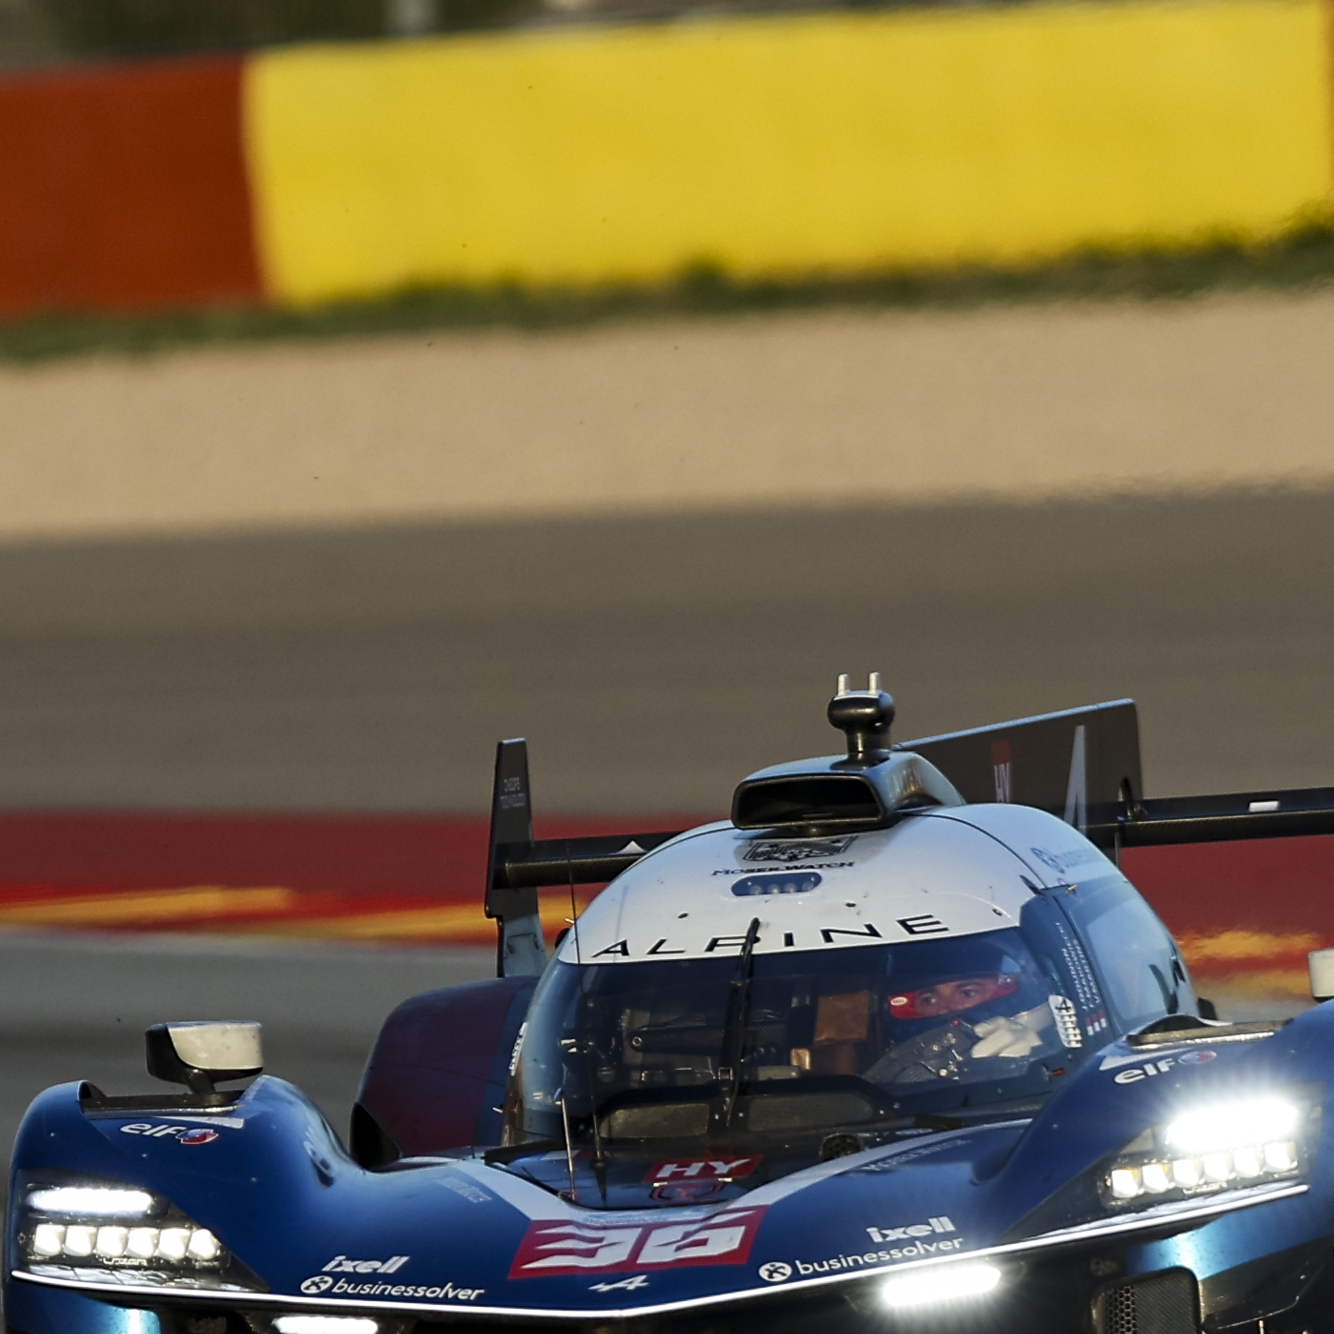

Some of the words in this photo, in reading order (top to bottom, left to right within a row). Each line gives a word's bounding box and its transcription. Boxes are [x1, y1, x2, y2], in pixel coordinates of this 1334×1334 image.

[592, 913, 949, 958] ALPINE
[1114, 1058, 1176, 1084] elf
[120, 1122, 188, 1138] elf
[654, 1158, 752, 1179] HY
[522, 1210, 756, 1268] 36
[866, 1215, 956, 1243] ixell
[321, 1255, 410, 1275] ixell
[798, 1236, 965, 1275] businessolver
[331, 1281, 486, 1301] businessolver
